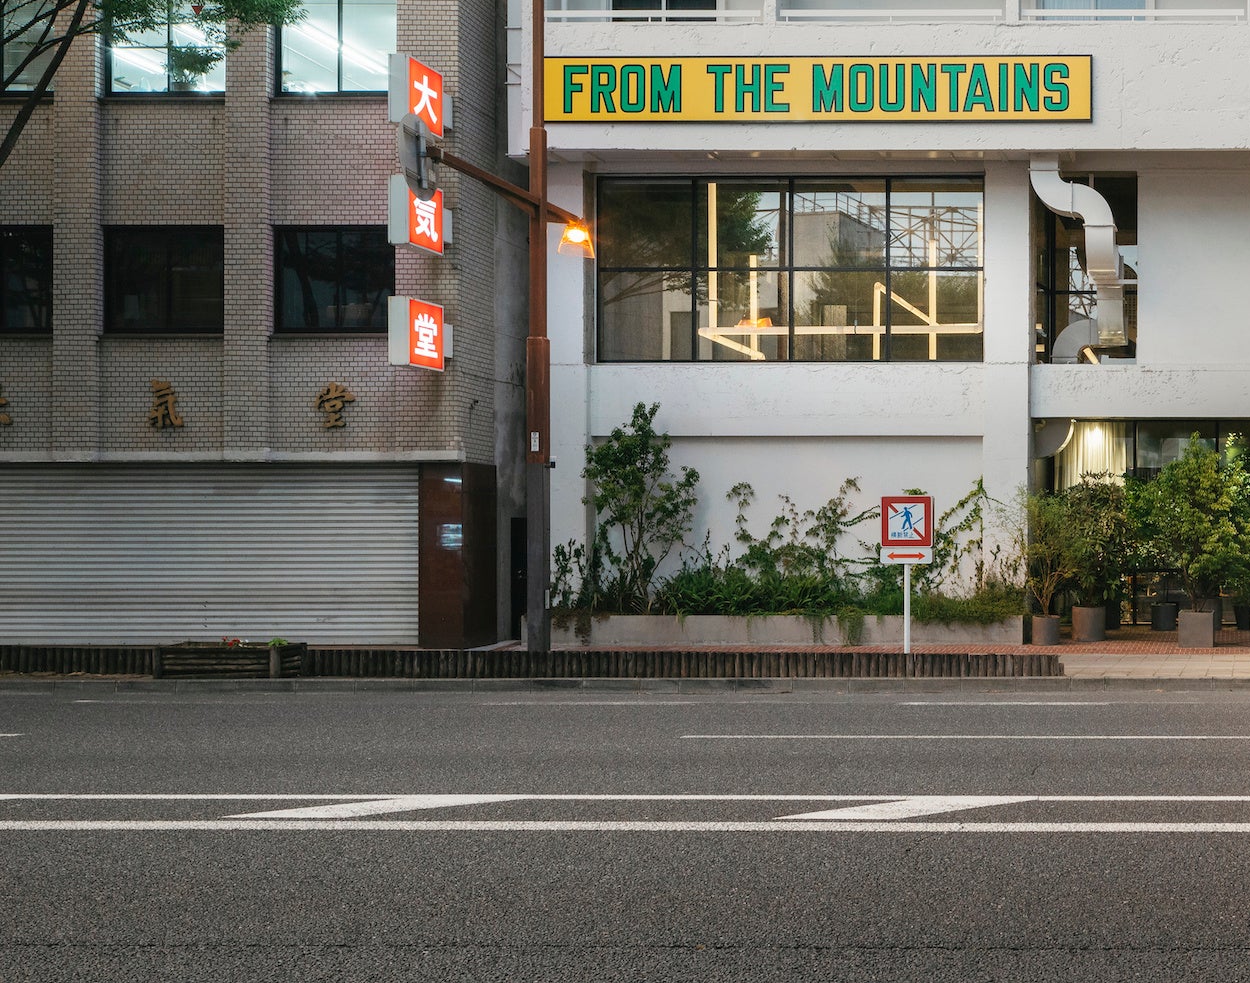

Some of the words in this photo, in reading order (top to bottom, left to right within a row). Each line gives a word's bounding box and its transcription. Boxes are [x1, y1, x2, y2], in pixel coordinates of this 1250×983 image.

[563, 63, 683, 114] FROM
[706, 63, 791, 113] THE
[812, 62, 1071, 113] MOUNTAINS
